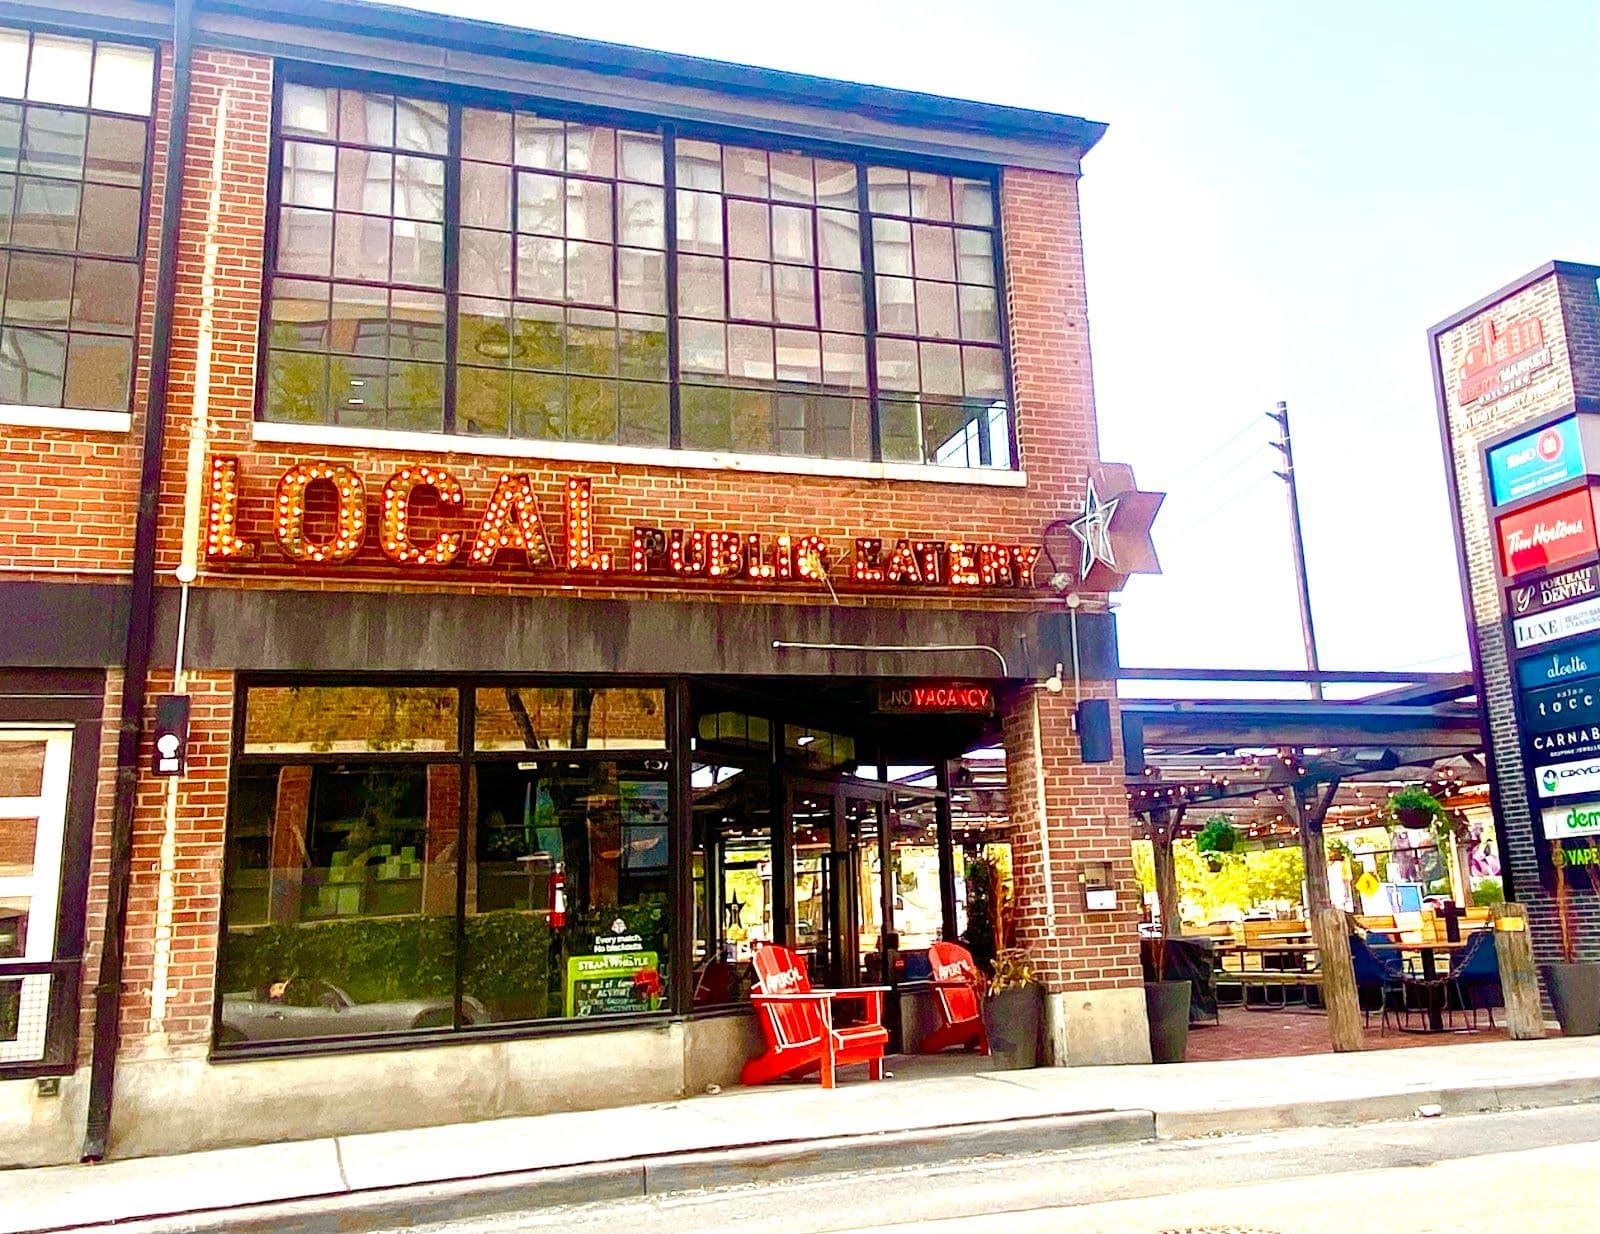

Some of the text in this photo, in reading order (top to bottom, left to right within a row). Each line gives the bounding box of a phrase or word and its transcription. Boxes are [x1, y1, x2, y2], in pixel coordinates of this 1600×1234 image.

[205, 455, 1042, 589] LOCAL PUBLIC EATERY
[1507, 519, 1584, 554] Tim Hortons
[1540, 567, 1592, 591] PORTRAIT
[1541, 579, 1596, 605] DENTAL
[1519, 619, 1558, 642] LUXE
[891, 689, 988, 707] NO VACANCY
[1534, 727, 1600, 750] CARNAB
[1567, 848, 1600, 866] VAPE
[594, 944, 606, 953] No
[595, 936, 616, 946] Every
[577, 960, 608, 971] STEAM
